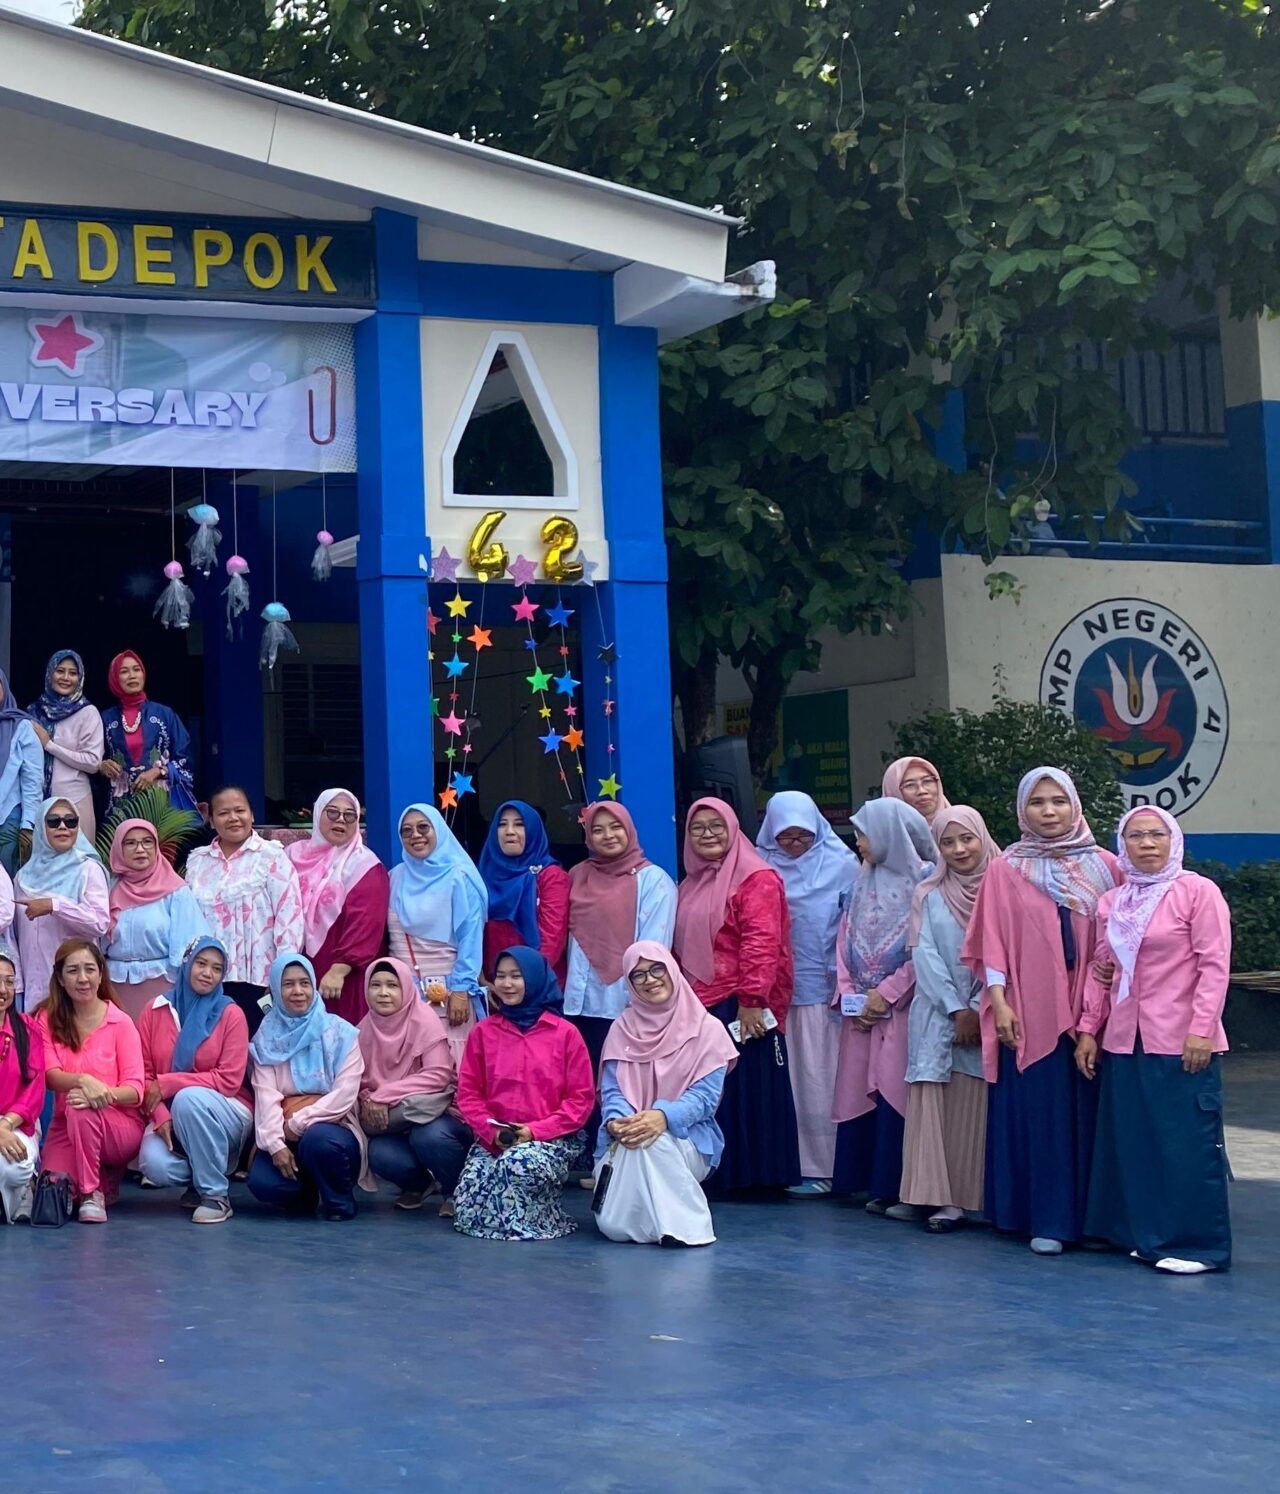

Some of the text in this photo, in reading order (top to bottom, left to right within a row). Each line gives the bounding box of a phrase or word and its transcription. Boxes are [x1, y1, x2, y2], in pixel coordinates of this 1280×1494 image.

[78, 221, 337, 293] DEPOK
[1048, 608, 1221, 734] MP NEGERI 4
[1130, 762, 1201, 811] POK
